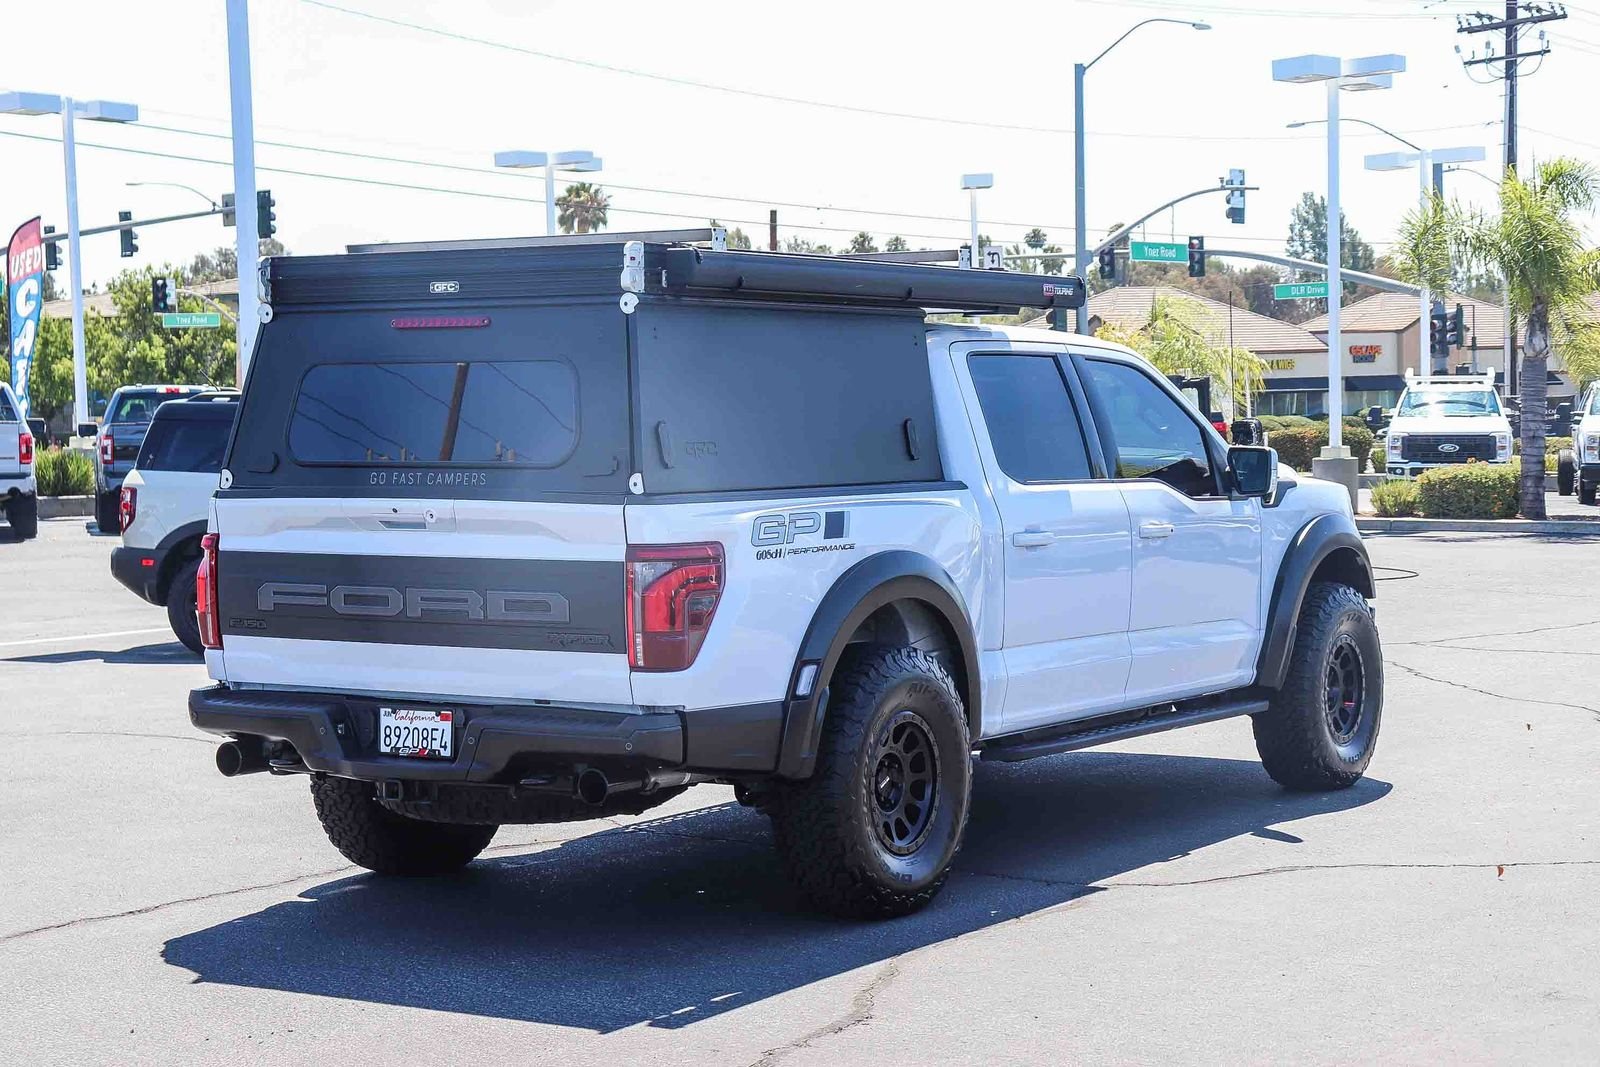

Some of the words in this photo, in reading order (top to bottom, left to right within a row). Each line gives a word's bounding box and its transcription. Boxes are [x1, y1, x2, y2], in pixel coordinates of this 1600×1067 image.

[1144, 245, 1159, 257] Ynez
[1160, 246, 1176, 258] Road
[11, 245, 41, 279] USED
[434, 283, 455, 292] GFC
[1290, 286, 1306, 295] DLR
[1307, 285, 1326, 294] Drive
[370, 472, 386, 485] GO
[392, 472, 423, 485] FAST
[427, 472, 487, 486] CAMPERS
[787, 543, 856, 555] PERFORMANCE
[257, 581, 570, 624] FORD
[395, 709, 436, 725] California
